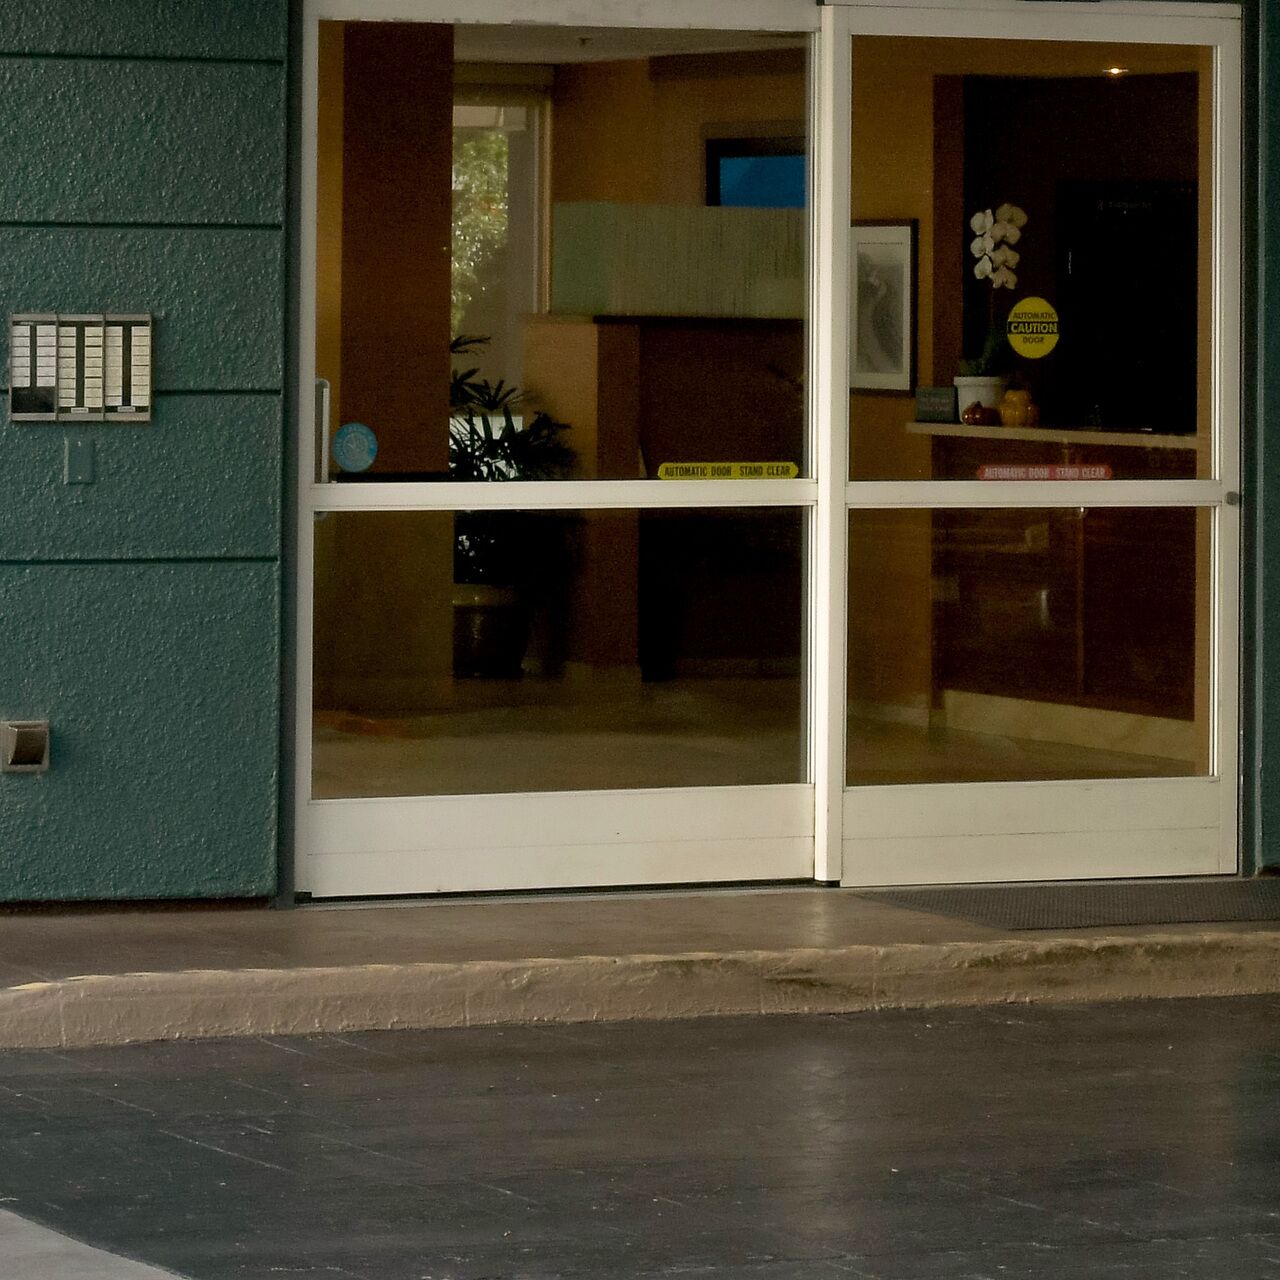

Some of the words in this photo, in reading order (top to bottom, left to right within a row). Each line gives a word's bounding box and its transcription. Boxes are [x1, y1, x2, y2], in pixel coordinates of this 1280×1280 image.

[1013, 311, 1055, 320] AUTOMATIC
[1010, 322, 1058, 333] CAUTION
[1022, 336, 1045, 344] DOOR
[664, 465, 708, 477] AUTOMATIC
[711, 465, 732, 477] DOOR
[739, 465, 763, 477] STAND
[766, 464, 791, 476] CLEAR
[984, 467, 1027, 480] AUTOMATIC
[1028, 467, 1049, 480] DOOR
[1055, 467, 1079, 480] STAND
[1081, 467, 1105, 480] CLEAR
